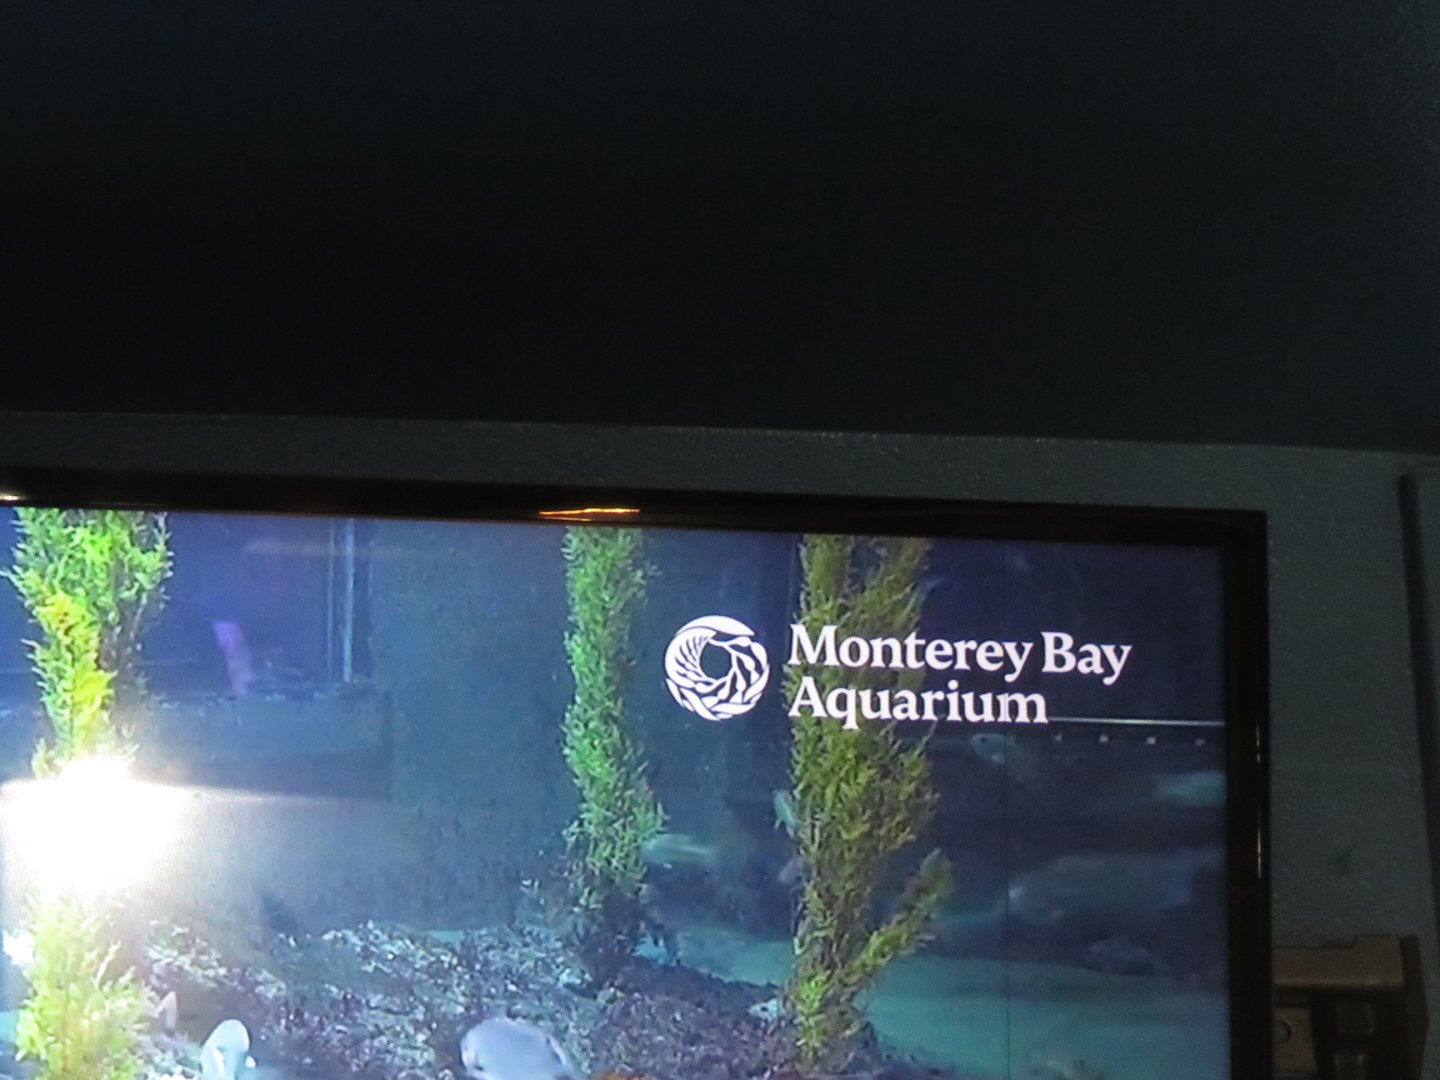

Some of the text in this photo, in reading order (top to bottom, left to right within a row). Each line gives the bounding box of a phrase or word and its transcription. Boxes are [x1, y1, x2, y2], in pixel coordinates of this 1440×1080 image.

[788, 623, 1133, 685] Monterey Bay
[787, 676, 1049, 730] Aquarium
